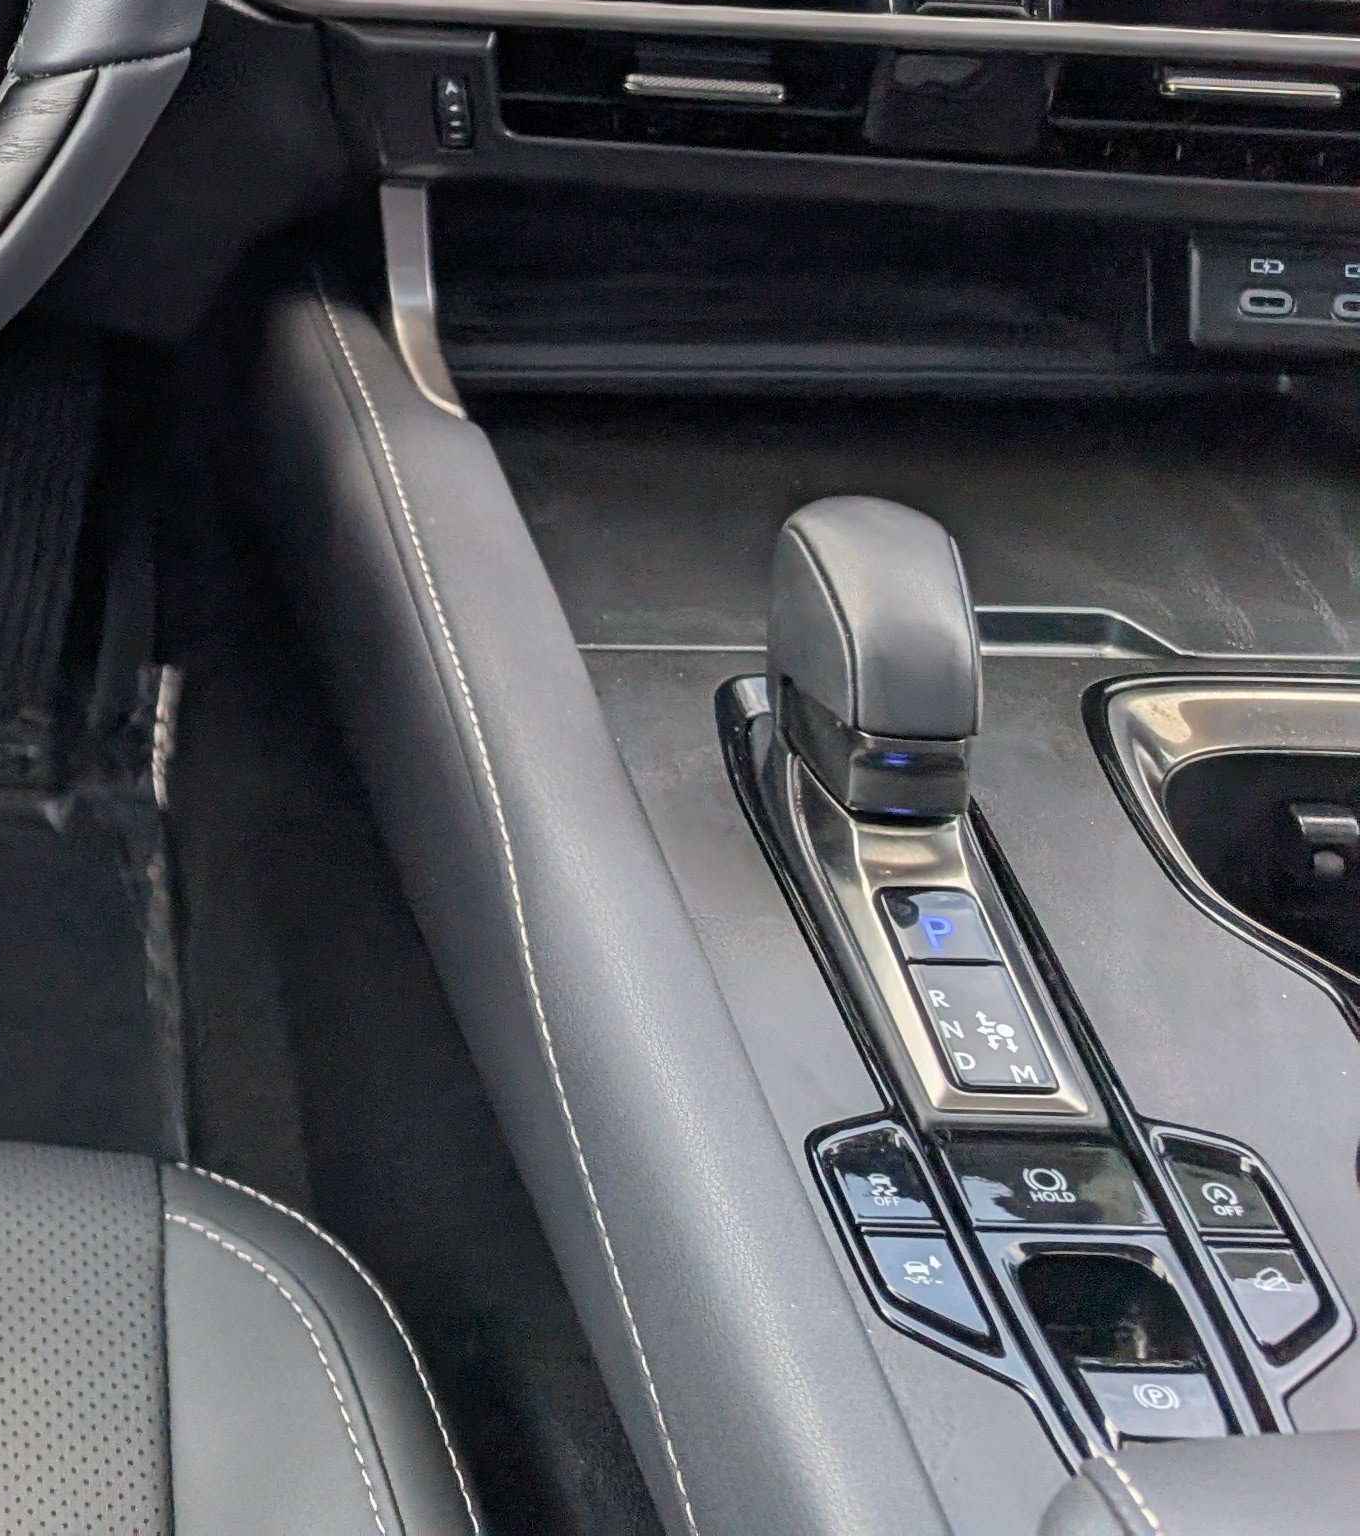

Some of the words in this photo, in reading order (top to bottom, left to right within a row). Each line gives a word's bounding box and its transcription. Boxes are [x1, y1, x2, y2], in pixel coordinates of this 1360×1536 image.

[918, 915, 953, 951] P
[928, 989, 951, 1008] R
[939, 1020, 965, 1039] N
[953, 1052, 976, 1071] D
[1009, 1064, 1039, 1084] M
[874, 1195, 901, 1207] OFF
[1029, 1190, 1077, 1204] HOLD
[1213, 1203, 1245, 1217] OFF
